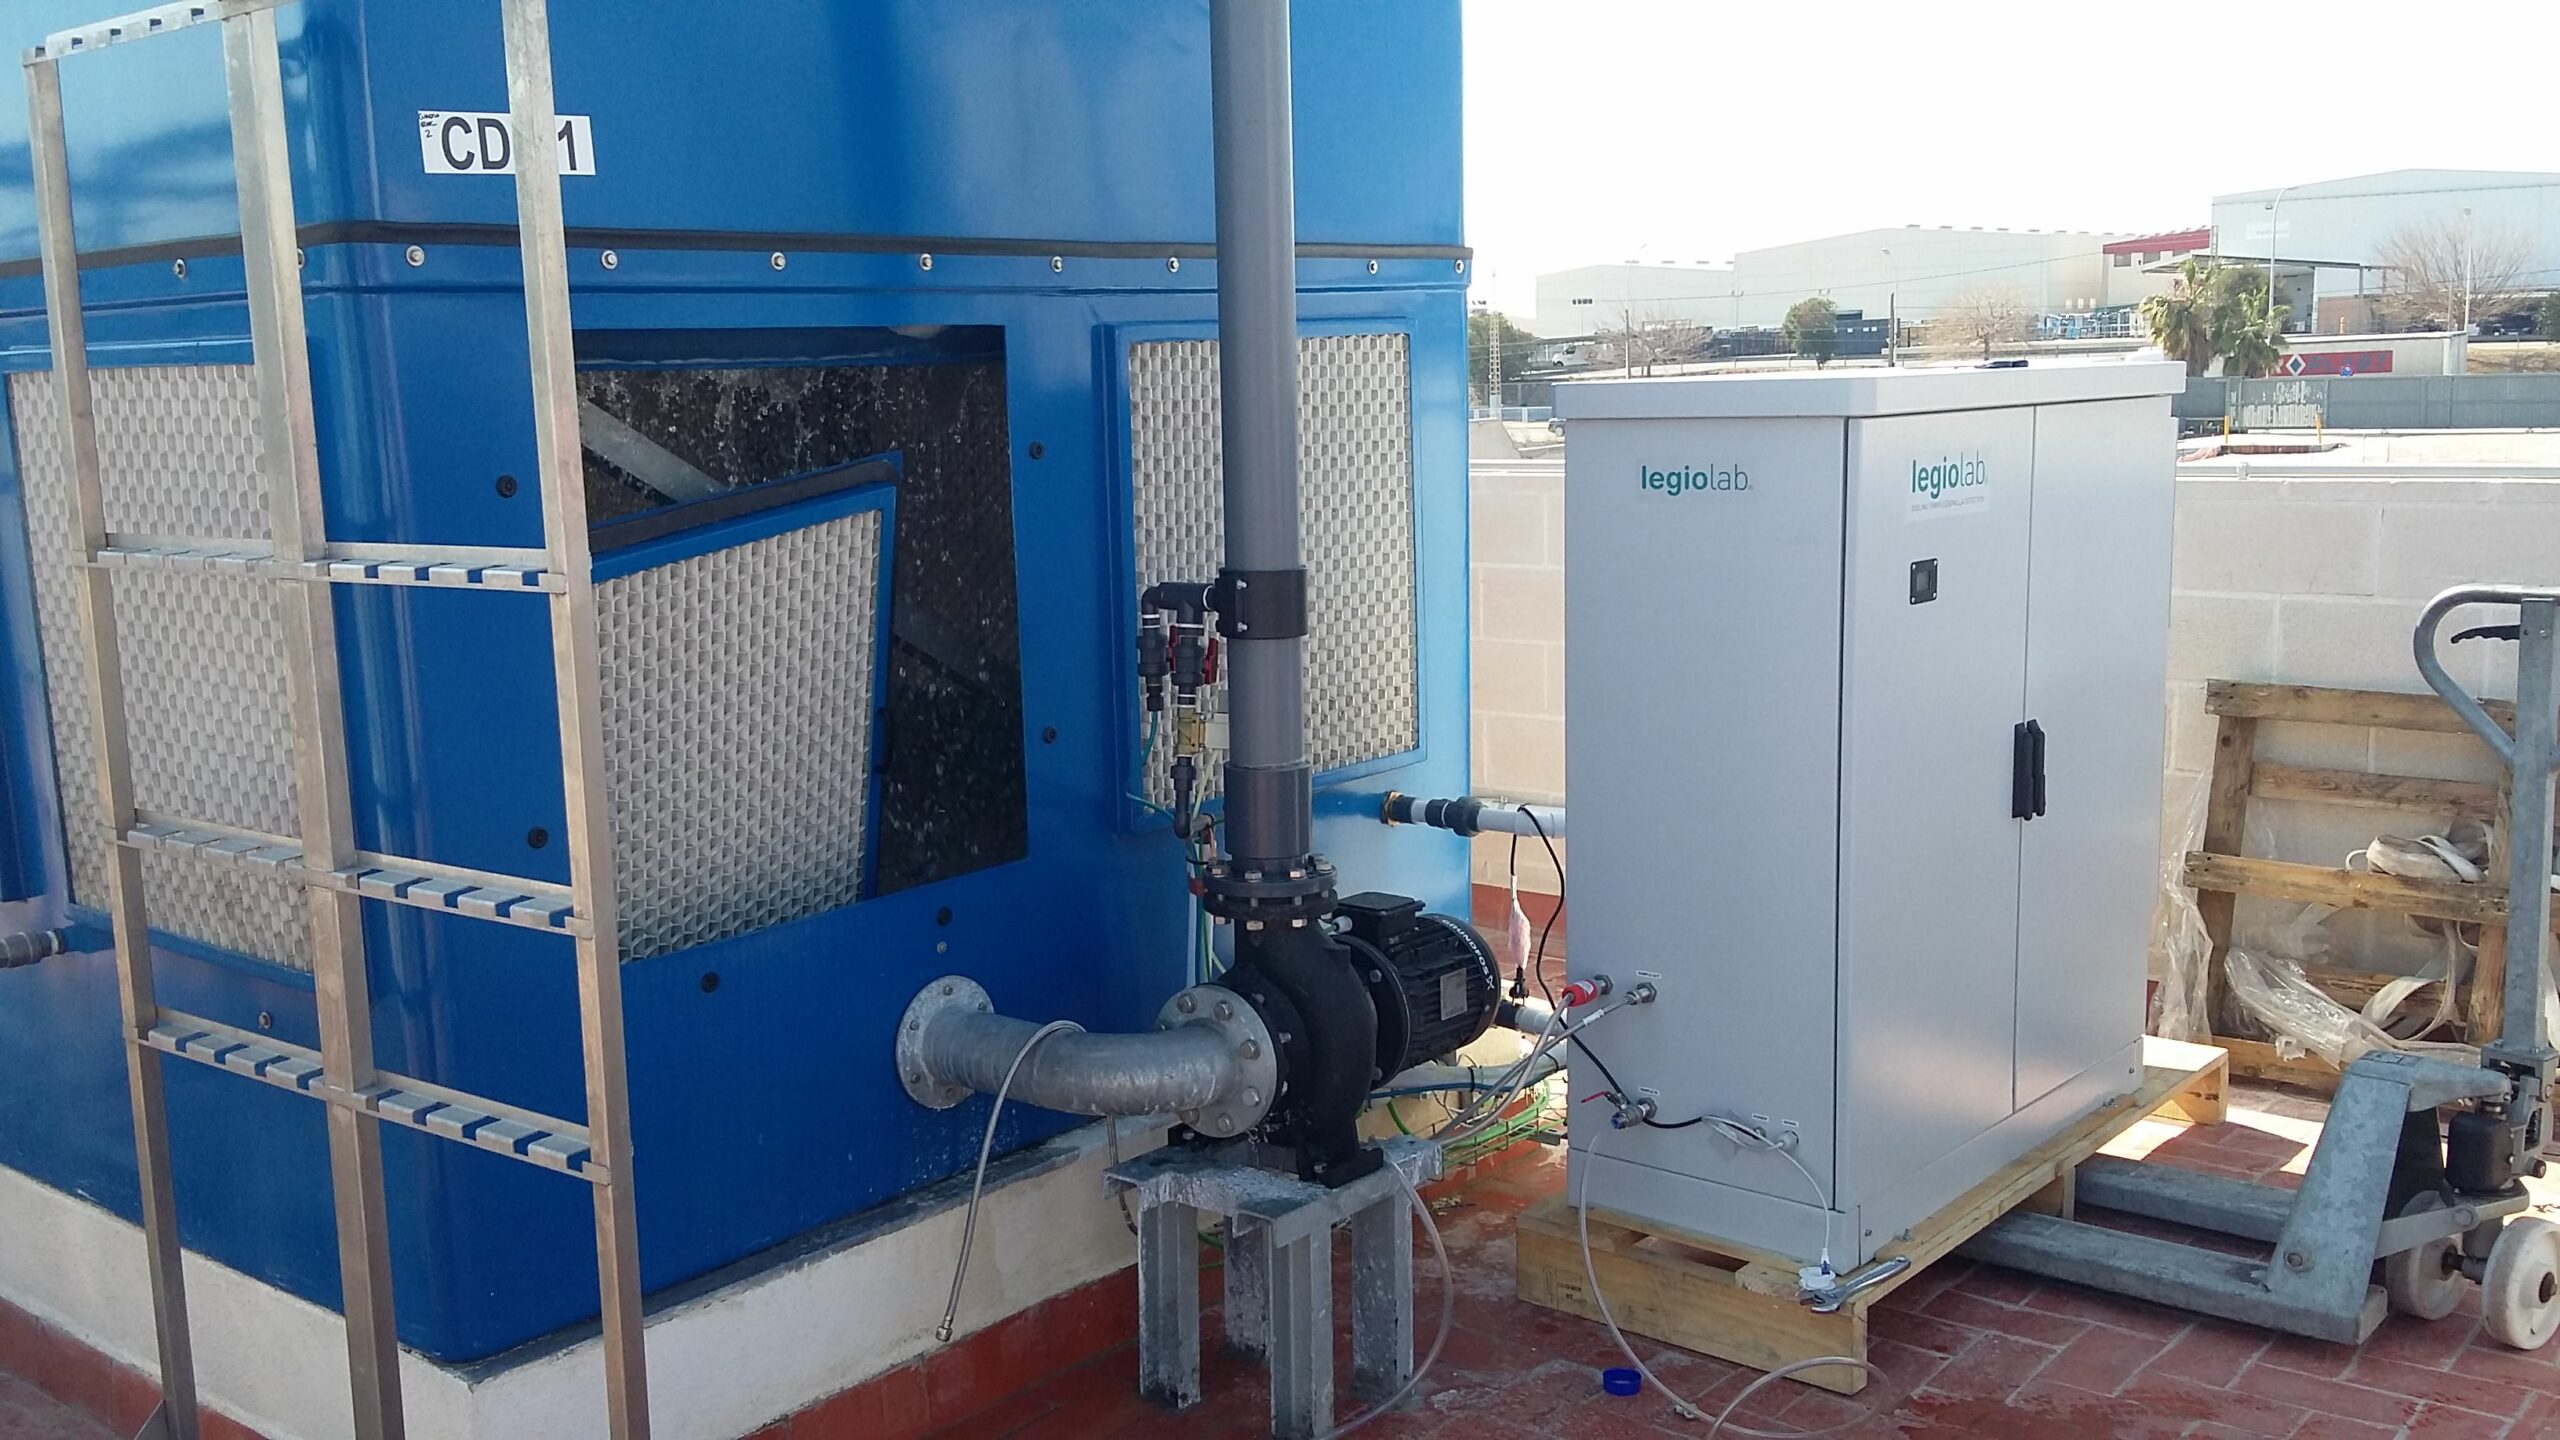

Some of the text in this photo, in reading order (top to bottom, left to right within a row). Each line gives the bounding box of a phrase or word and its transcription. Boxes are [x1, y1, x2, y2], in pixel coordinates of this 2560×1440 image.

[441, 116, 577, 171] CD1
[1641, 463, 1748, 496] legiolab
[1912, 449, 1985, 499] legiolab
[1441, 919, 1489, 975] GRUNDFOS
